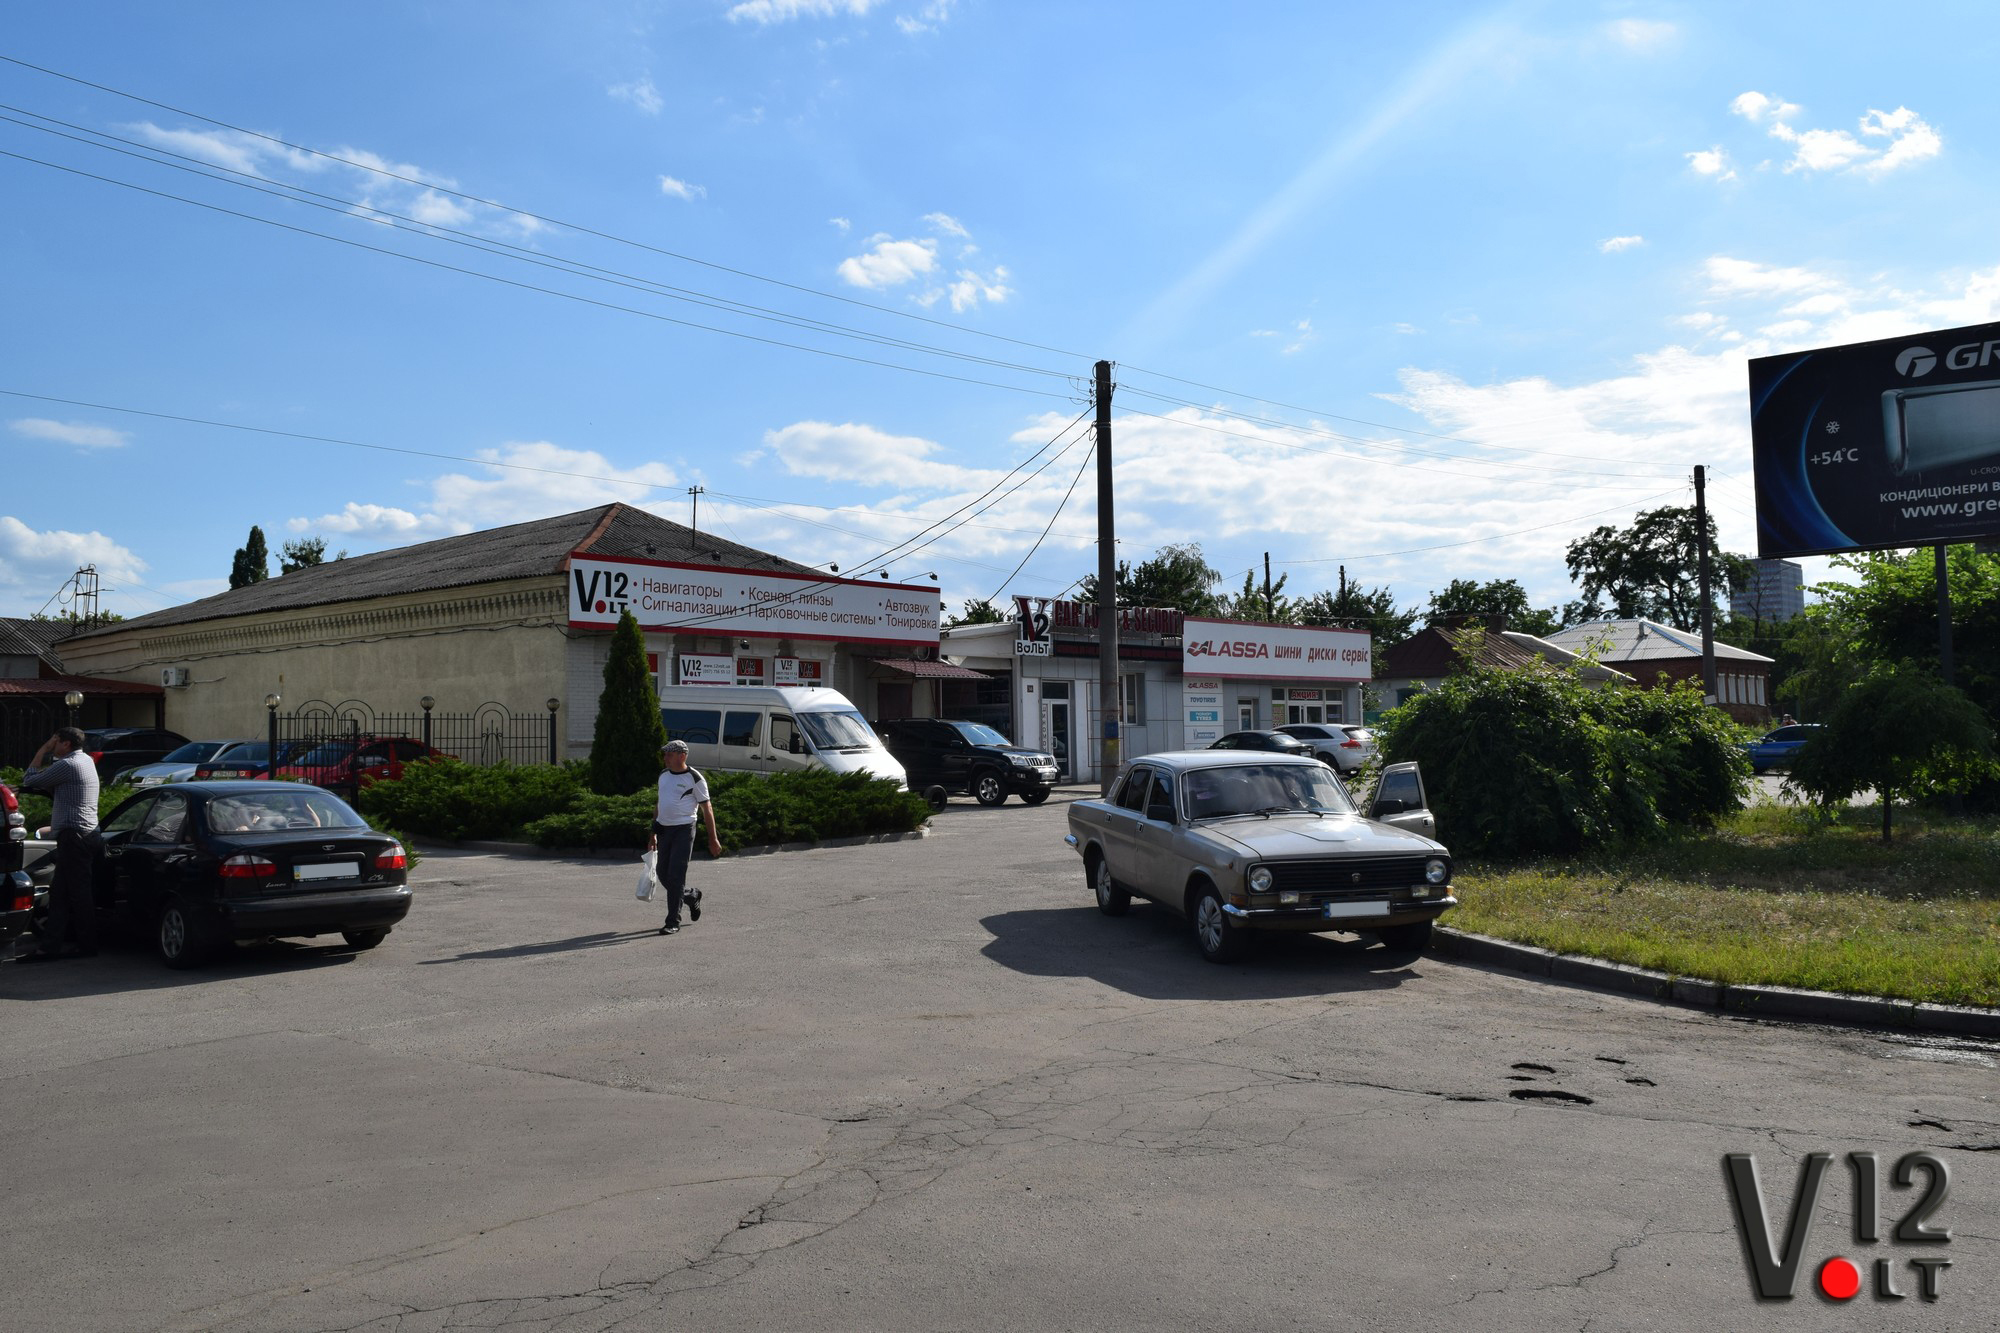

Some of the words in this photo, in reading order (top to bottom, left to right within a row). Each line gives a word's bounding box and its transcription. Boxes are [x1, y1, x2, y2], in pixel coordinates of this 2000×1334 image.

[1880, 482, 1988, 502] КОНДИЦІОНЕРИ
[1901, 499, 2000, 518] www.gre
[642, 578, 722, 599] Навигаторы
[748, 587, 795, 603] Ксенон,
[799, 593, 834, 607] линзы
[642, 596, 737, 617] Сигнализации
[748, 604, 828, 622] Парковочные
[831, 612, 876, 626] системы
[885, 599, 930, 617] Автозвук
[885, 613, 937, 630] Тонировка
[1054, 600, 1079, 627] CAR
[1122, 609, 1131, 632] &
[1134, 607, 1185, 635] SECURITY
[1207, 640, 1269, 659] LASSA
[1274, 645, 1302, 659] шини
[1308, 647, 1337, 663] диски
[1341, 647, 1368, 666] сервіс
